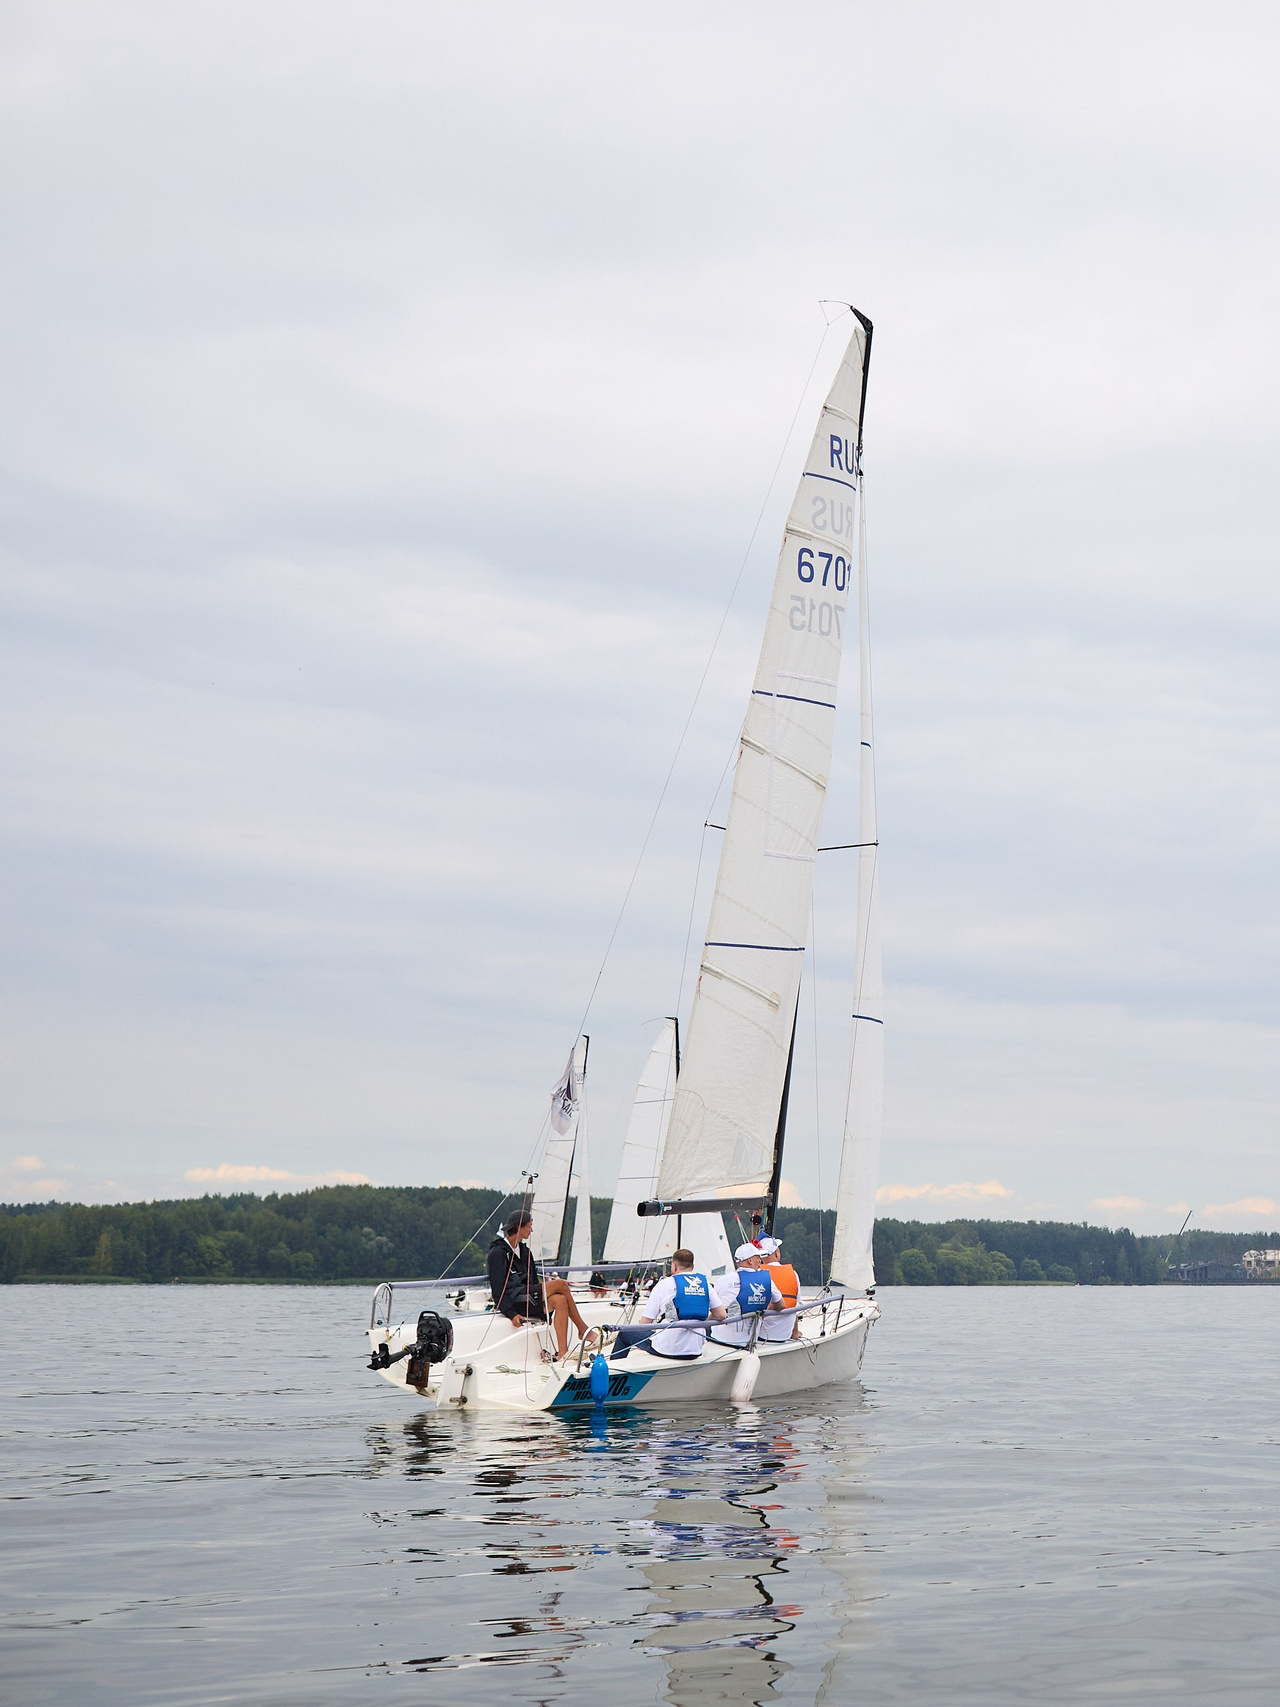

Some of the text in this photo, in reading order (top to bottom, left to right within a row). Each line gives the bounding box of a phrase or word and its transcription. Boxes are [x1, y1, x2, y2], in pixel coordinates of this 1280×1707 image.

[563, 1376, 631, 1397] РАКЕ 70 15
